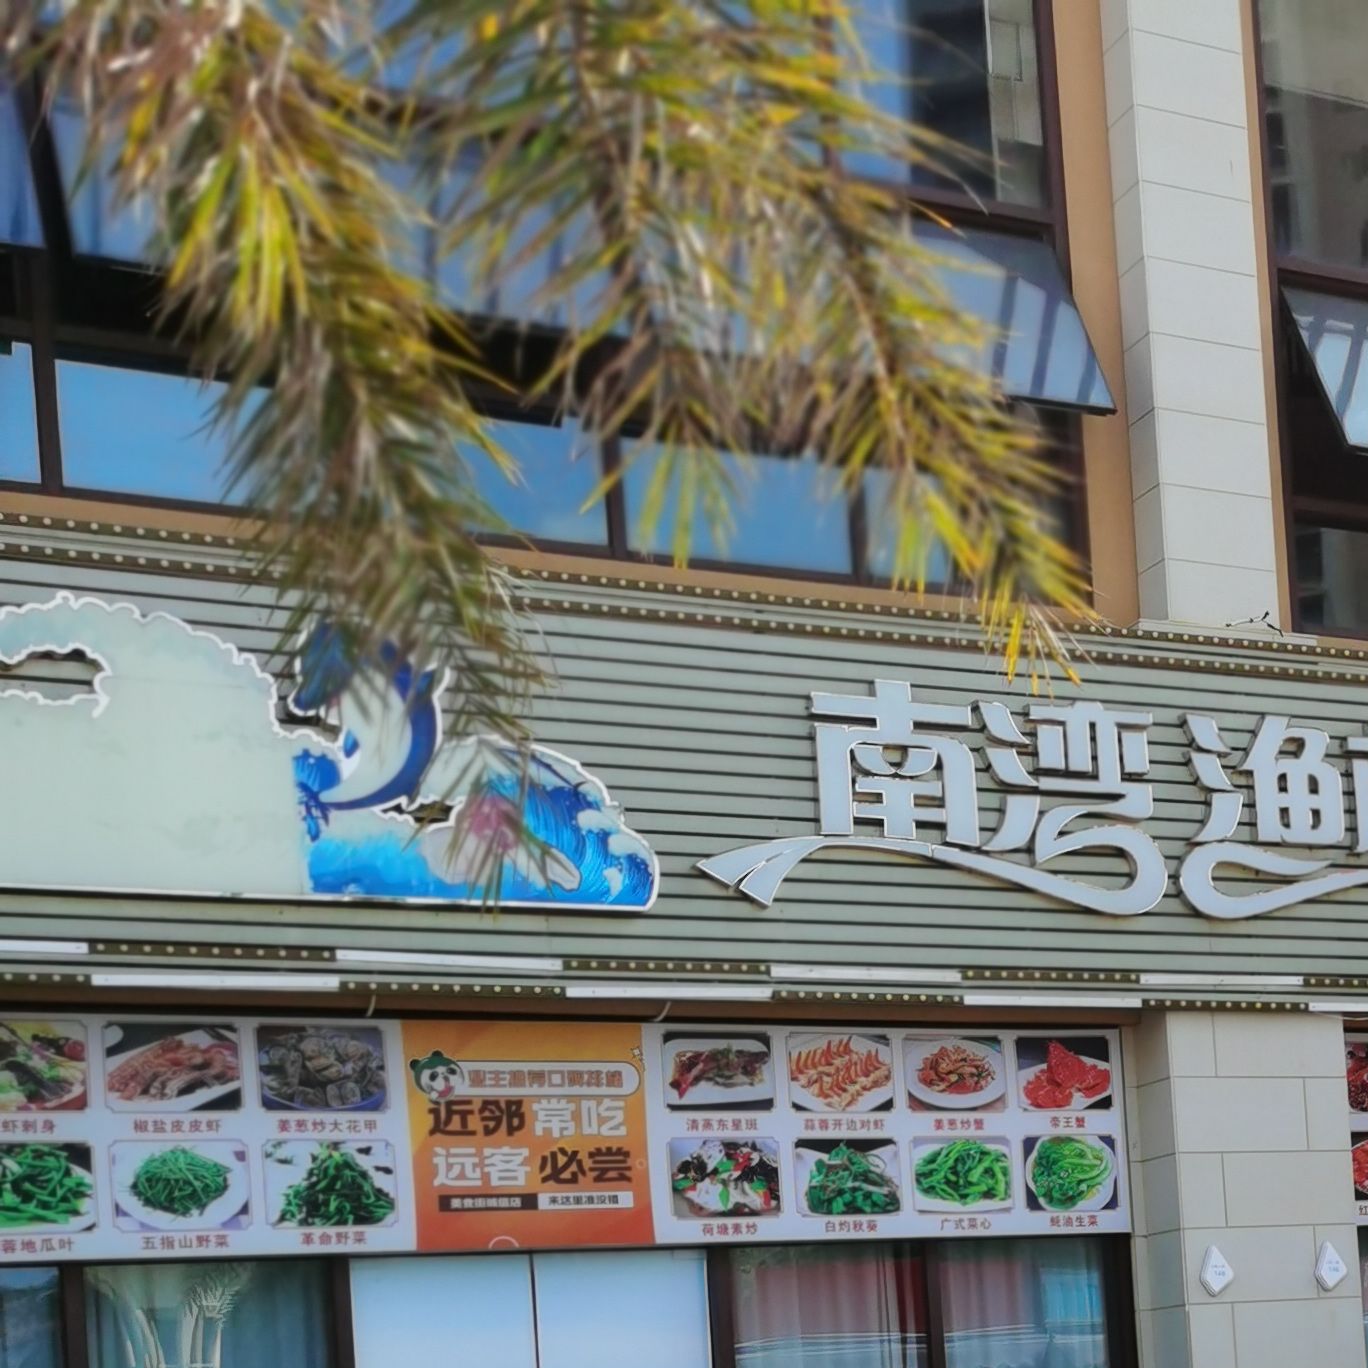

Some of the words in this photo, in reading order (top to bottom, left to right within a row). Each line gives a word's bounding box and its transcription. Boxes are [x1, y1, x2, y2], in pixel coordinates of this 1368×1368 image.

[133, 1119, 222, 1134] 椒盐皮皮虾
[277, 1119, 379, 1134] 姜葱炒大花甲
[428, 1099, 628, 1137] 近邻常吃
[685, 1118, 759, 1132] 清蒸东星斑
[803, 1117, 886, 1132] 蒜蓉开边对虾
[1049, 1116, 1086, 1130] 帝王蟹
[433, 1146, 632, 1186] 远客必尝
[824, 1219, 878, 1233] 白灼秋葵
[940, 1217, 992, 1231] 广式菜心
[141, 1236, 229, 1250] 五指山野菜
[301, 1231, 367, 1246] 革命野菜
